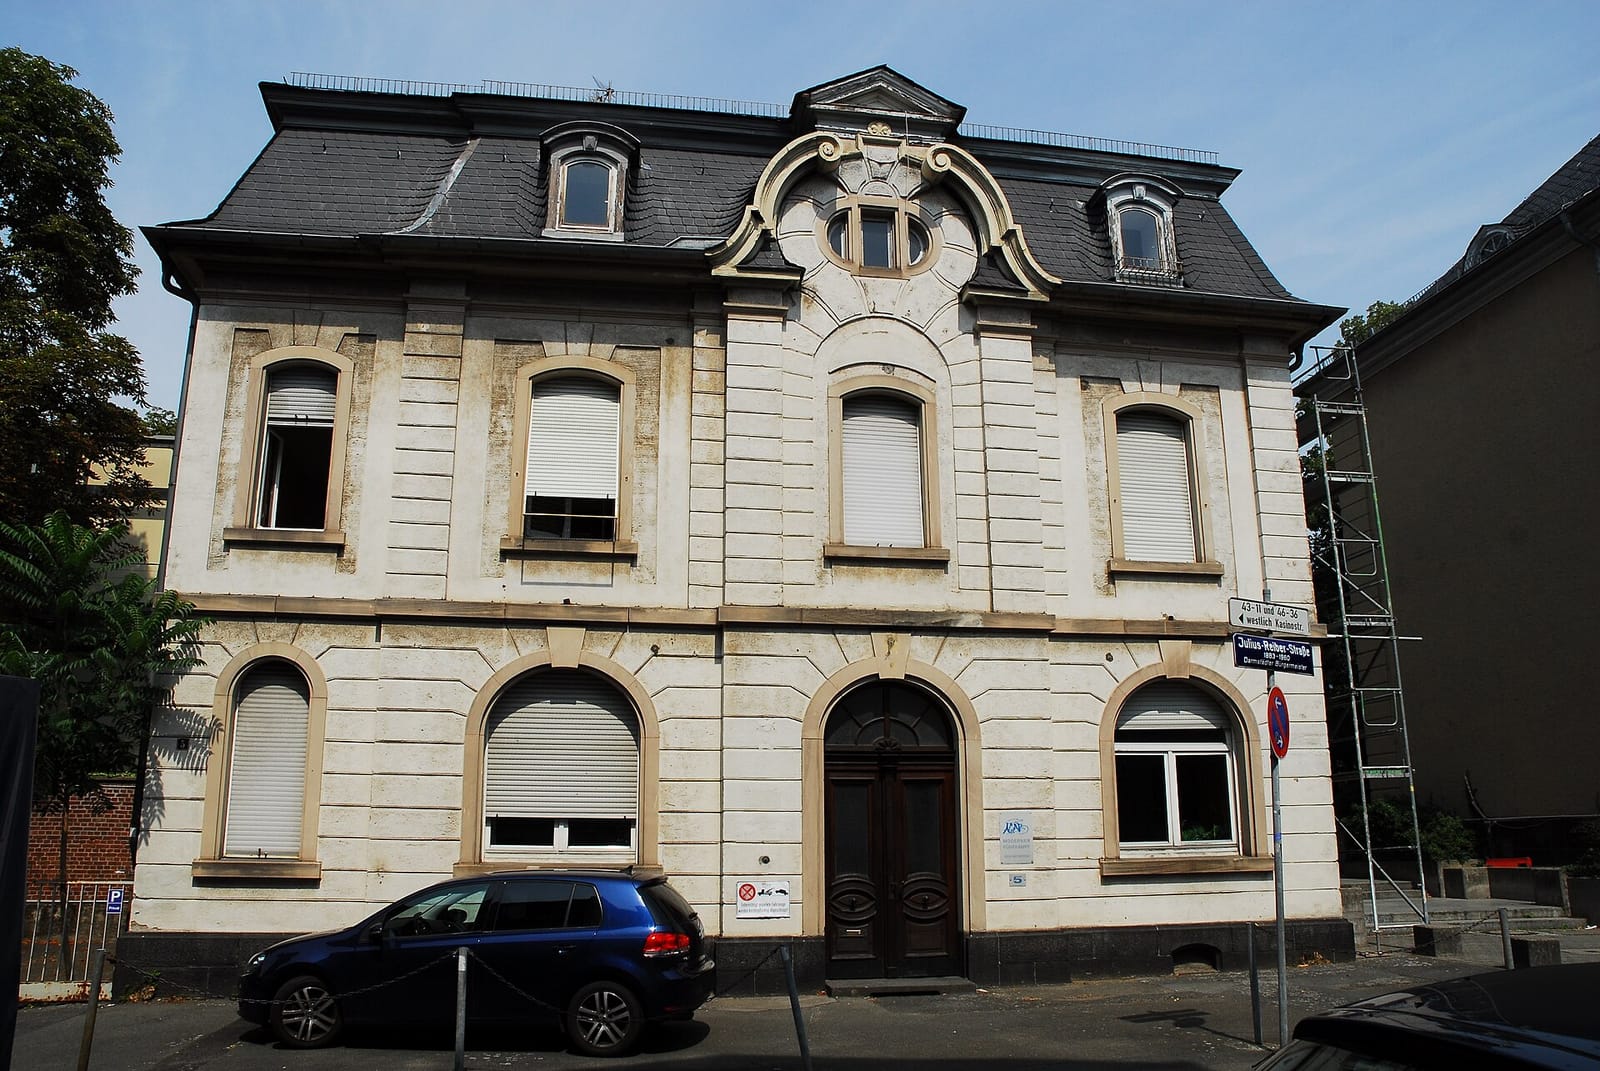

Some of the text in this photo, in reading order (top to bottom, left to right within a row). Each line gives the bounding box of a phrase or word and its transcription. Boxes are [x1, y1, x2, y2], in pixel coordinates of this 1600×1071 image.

[1242, 602, 1299, 619] 43-11 und 46-36
[1246, 616, 1304, 631] westlich Kasinostr.
[1237, 636, 1311, 658] Julius-Reiber-Straße
[1013, 875, 1022, 884] 5
[111, 891, 120, 902] P
